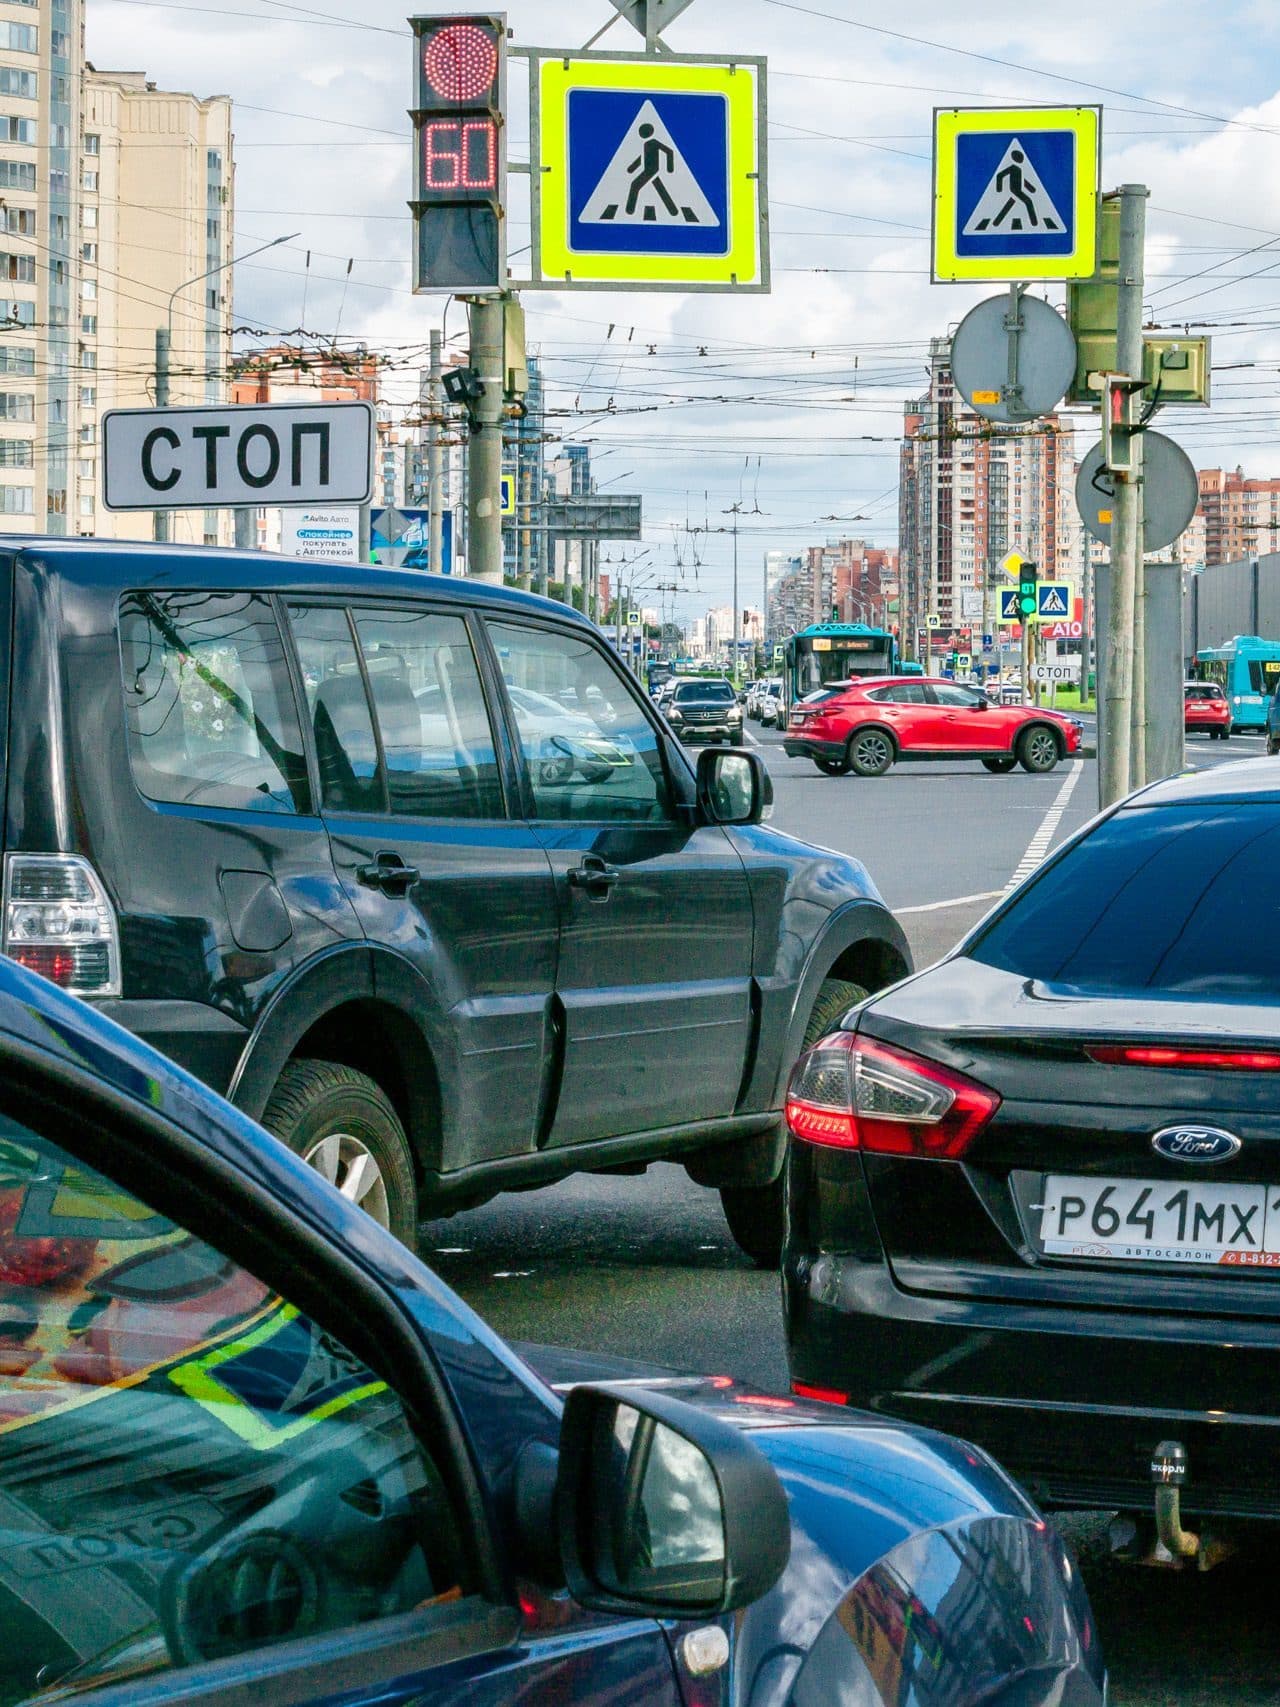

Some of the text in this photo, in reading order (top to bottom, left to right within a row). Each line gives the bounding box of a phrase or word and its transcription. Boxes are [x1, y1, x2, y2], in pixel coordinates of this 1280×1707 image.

[426, 123, 495, 188] 60
[141, 422, 330, 491] СТОП
[298, 530, 351, 538] Спокойнее
[303, 548, 353, 556] Автотекой
[1037, 667, 1071, 678] СТОП
[1170, 1132, 1219, 1153] Ford
[1126, 1248, 1211, 1259] автосалон
